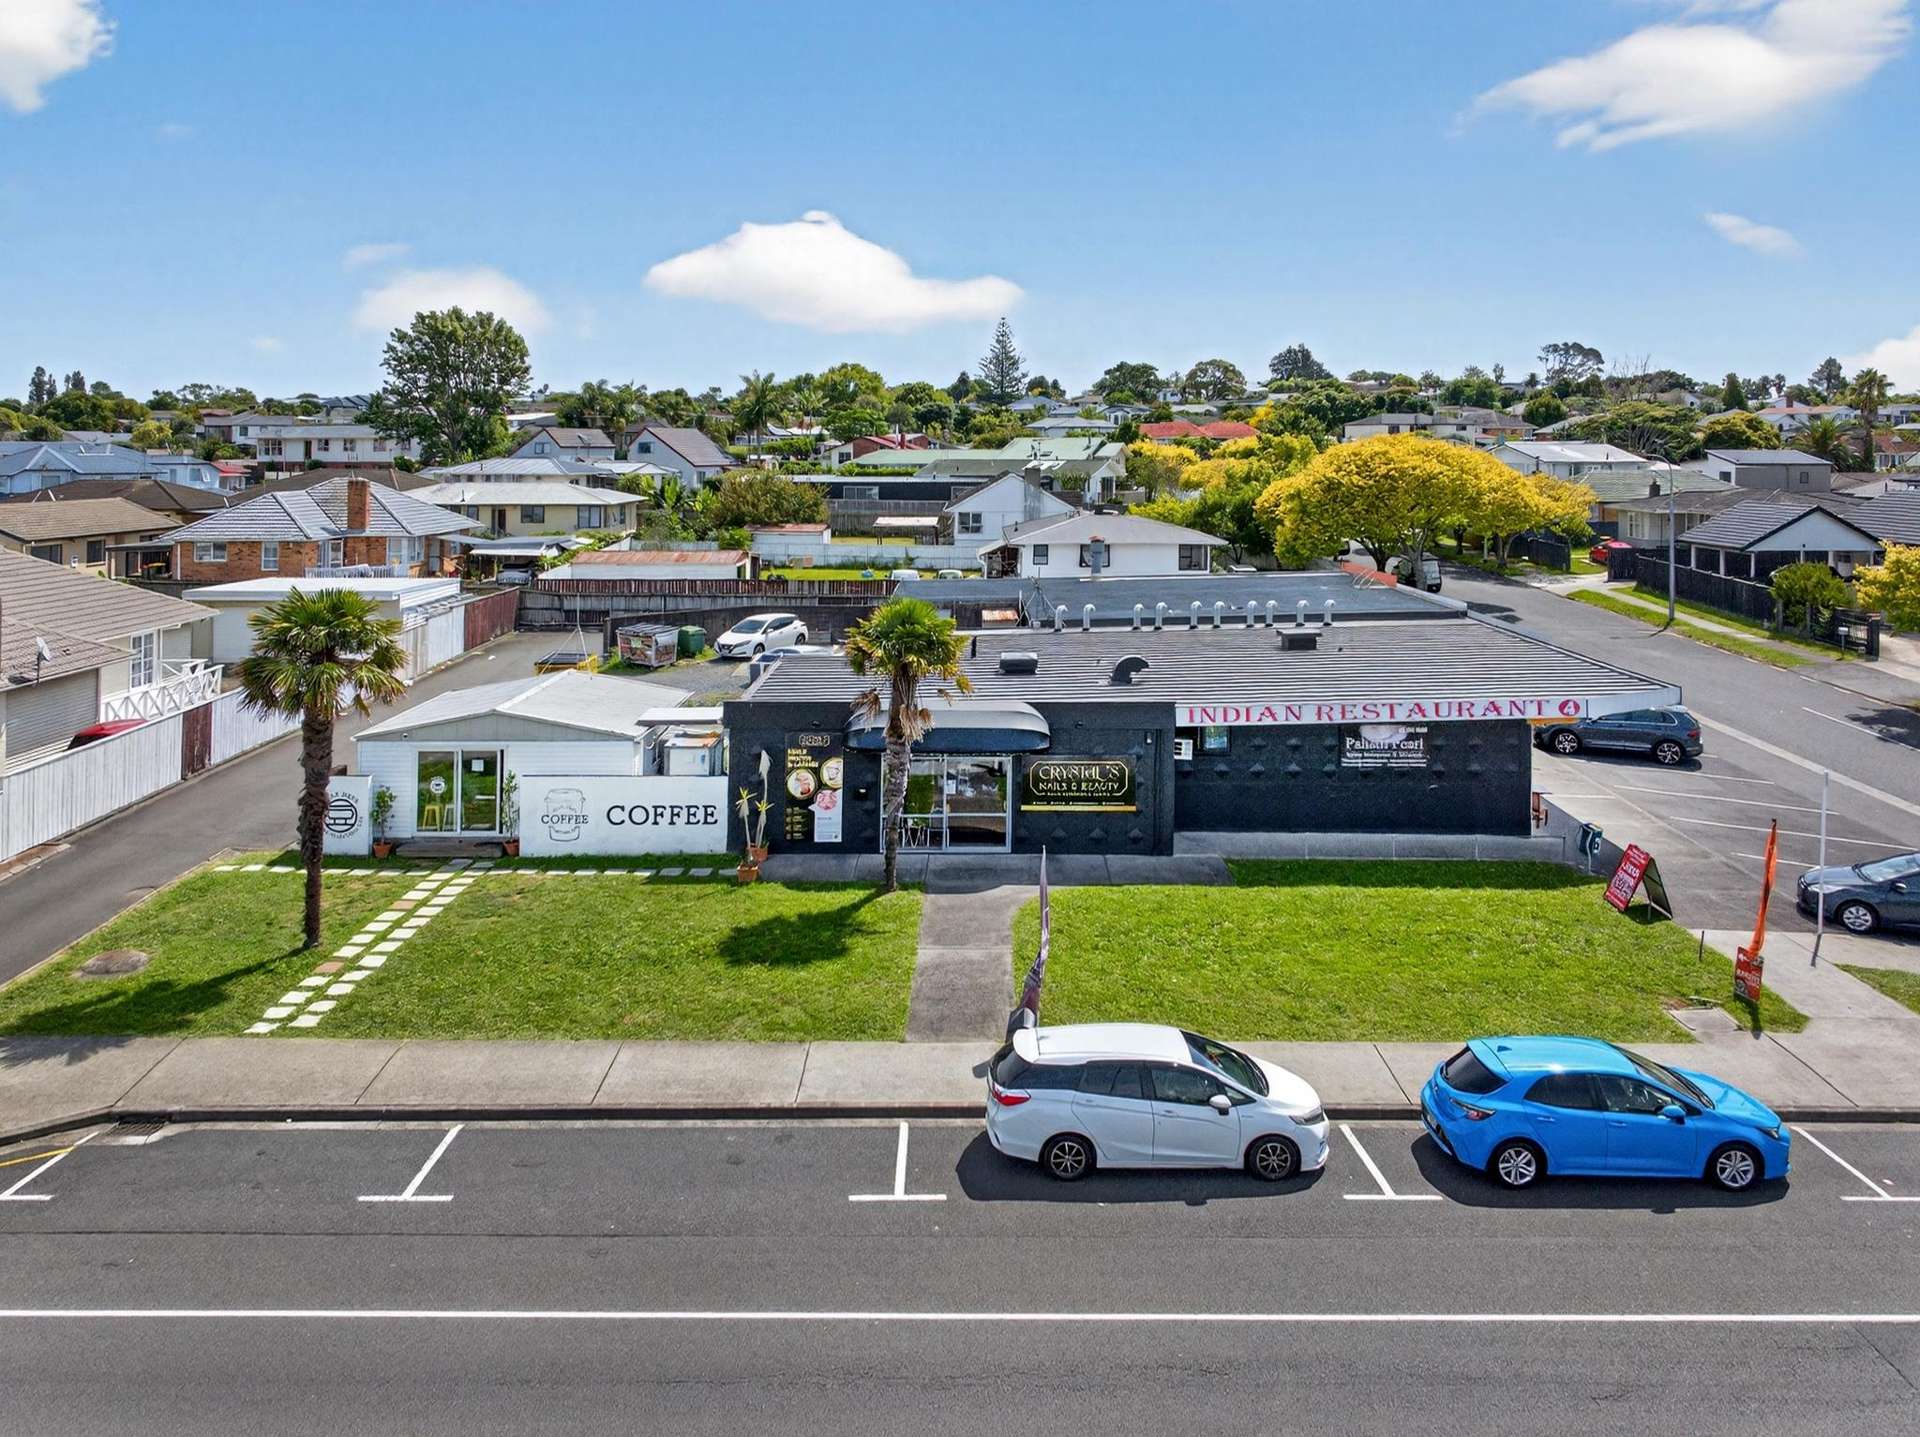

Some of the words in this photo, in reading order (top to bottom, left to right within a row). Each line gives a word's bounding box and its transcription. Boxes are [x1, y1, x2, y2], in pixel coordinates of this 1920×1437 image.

[1188, 704, 1302, 723] INDIAN
[1315, 699, 1550, 721] RESTAURANT
[1081, 782, 1120, 791] BEAUTY
[541, 814, 589, 824] COFFEE
[607, 804, 718, 826] COFFEE
